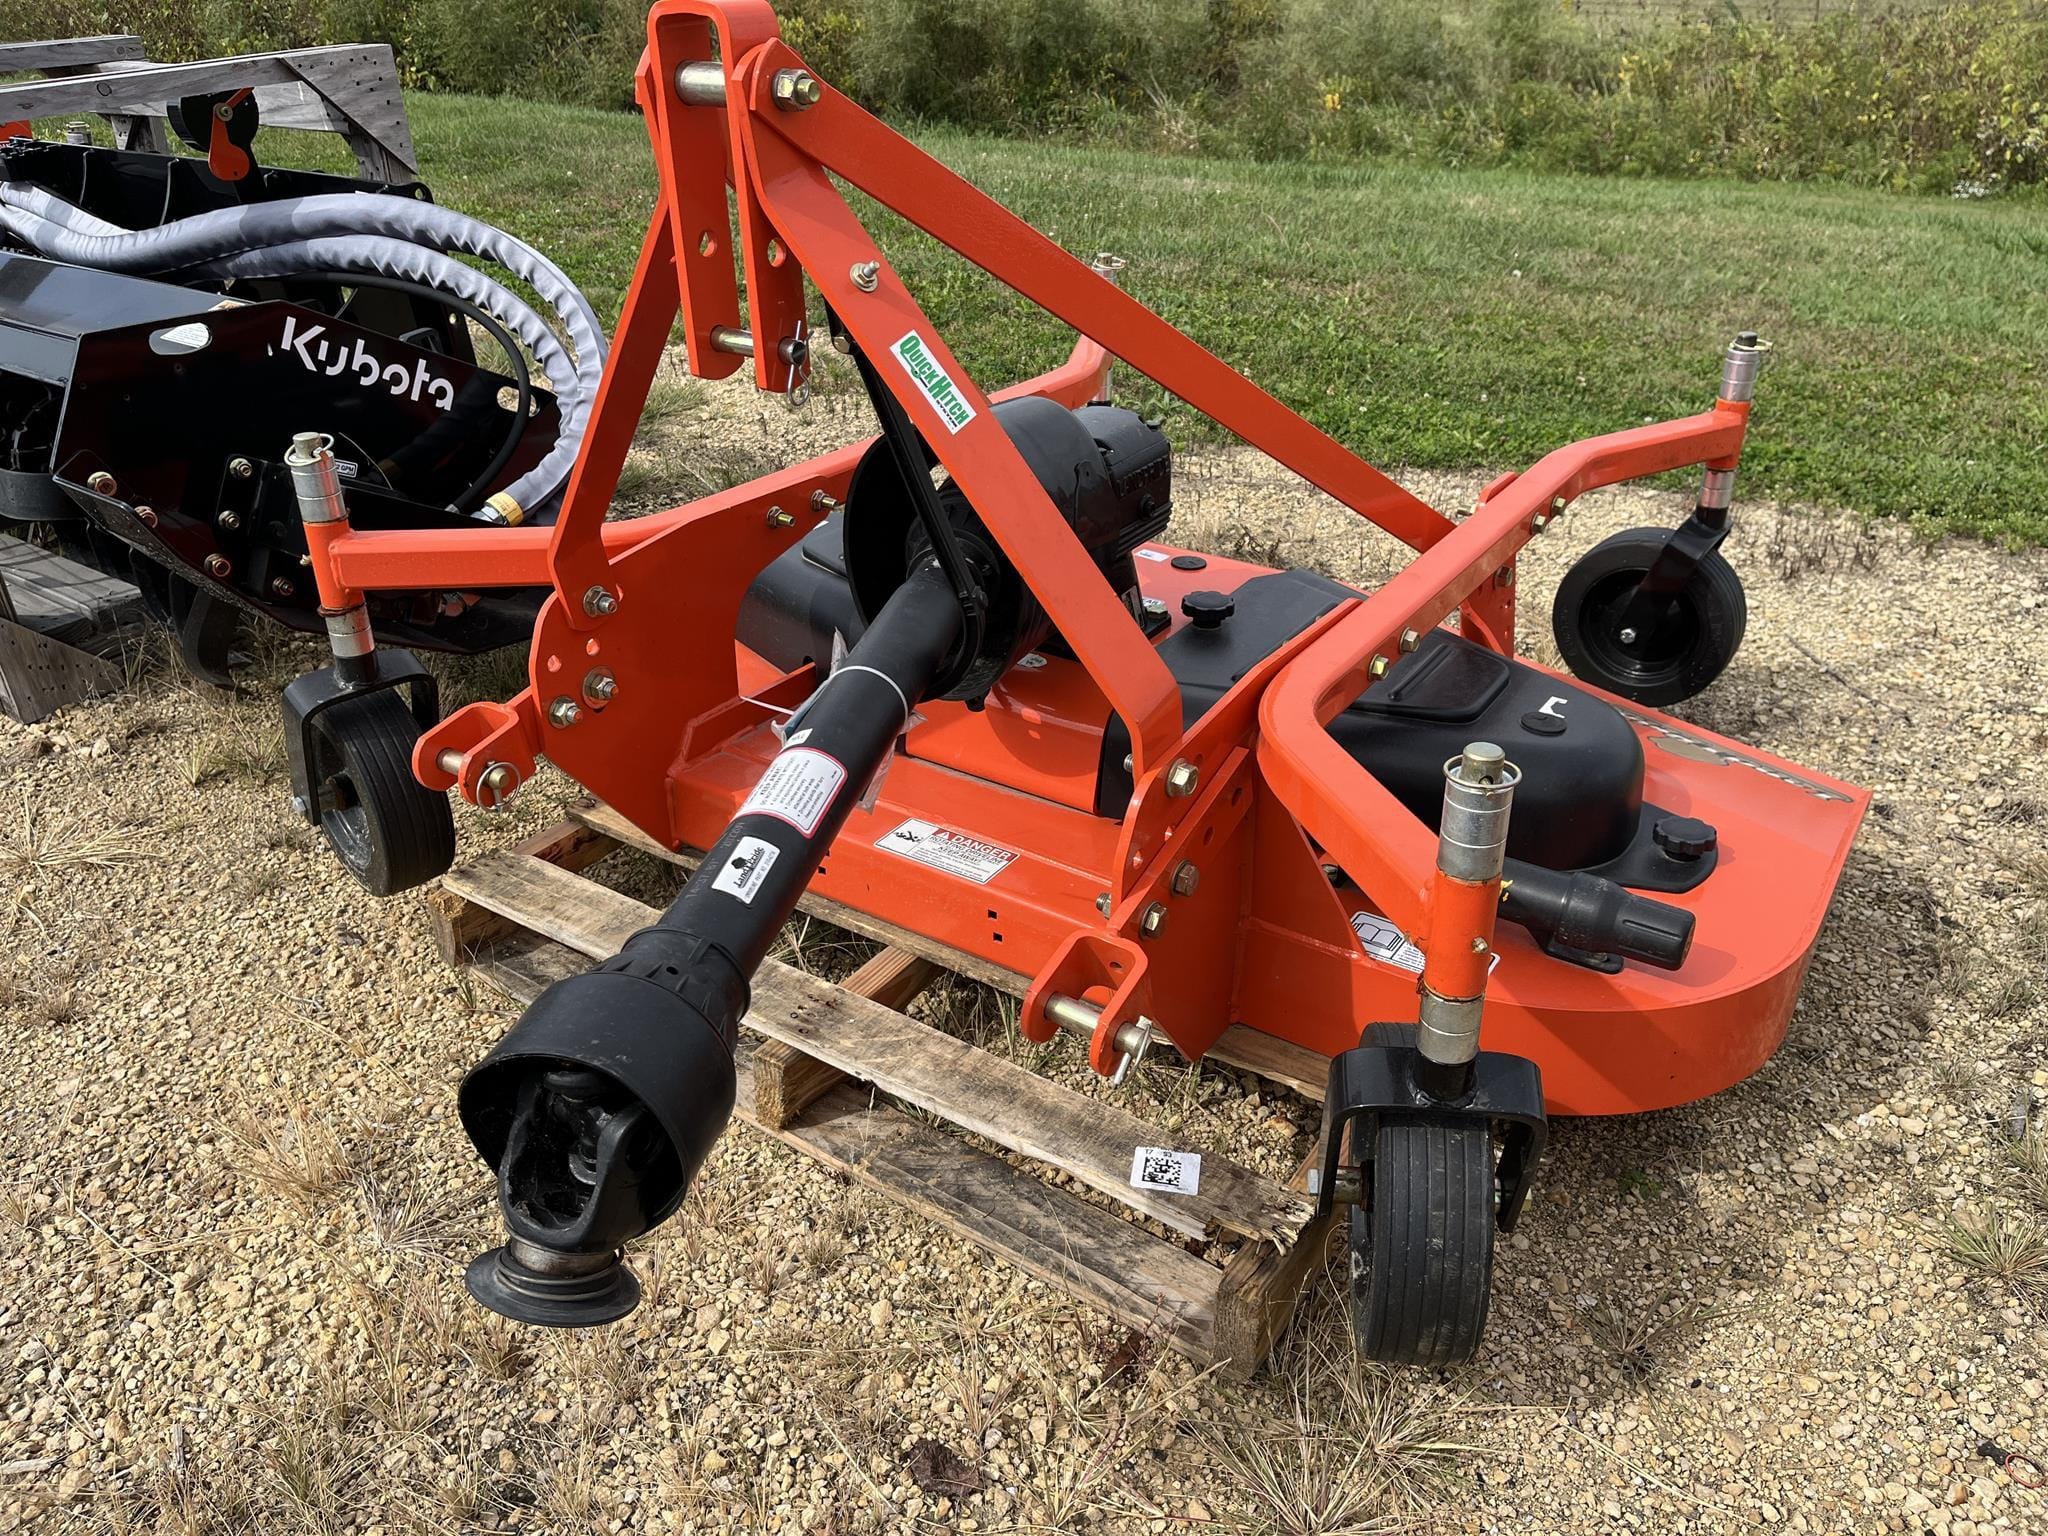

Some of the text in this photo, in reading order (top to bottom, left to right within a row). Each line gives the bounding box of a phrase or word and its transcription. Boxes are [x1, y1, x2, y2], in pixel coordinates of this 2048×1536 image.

[280, 315, 455, 411] Kubota
[731, 846, 764, 888] Land Pride
[951, 836, 1012, 860] DANGER
